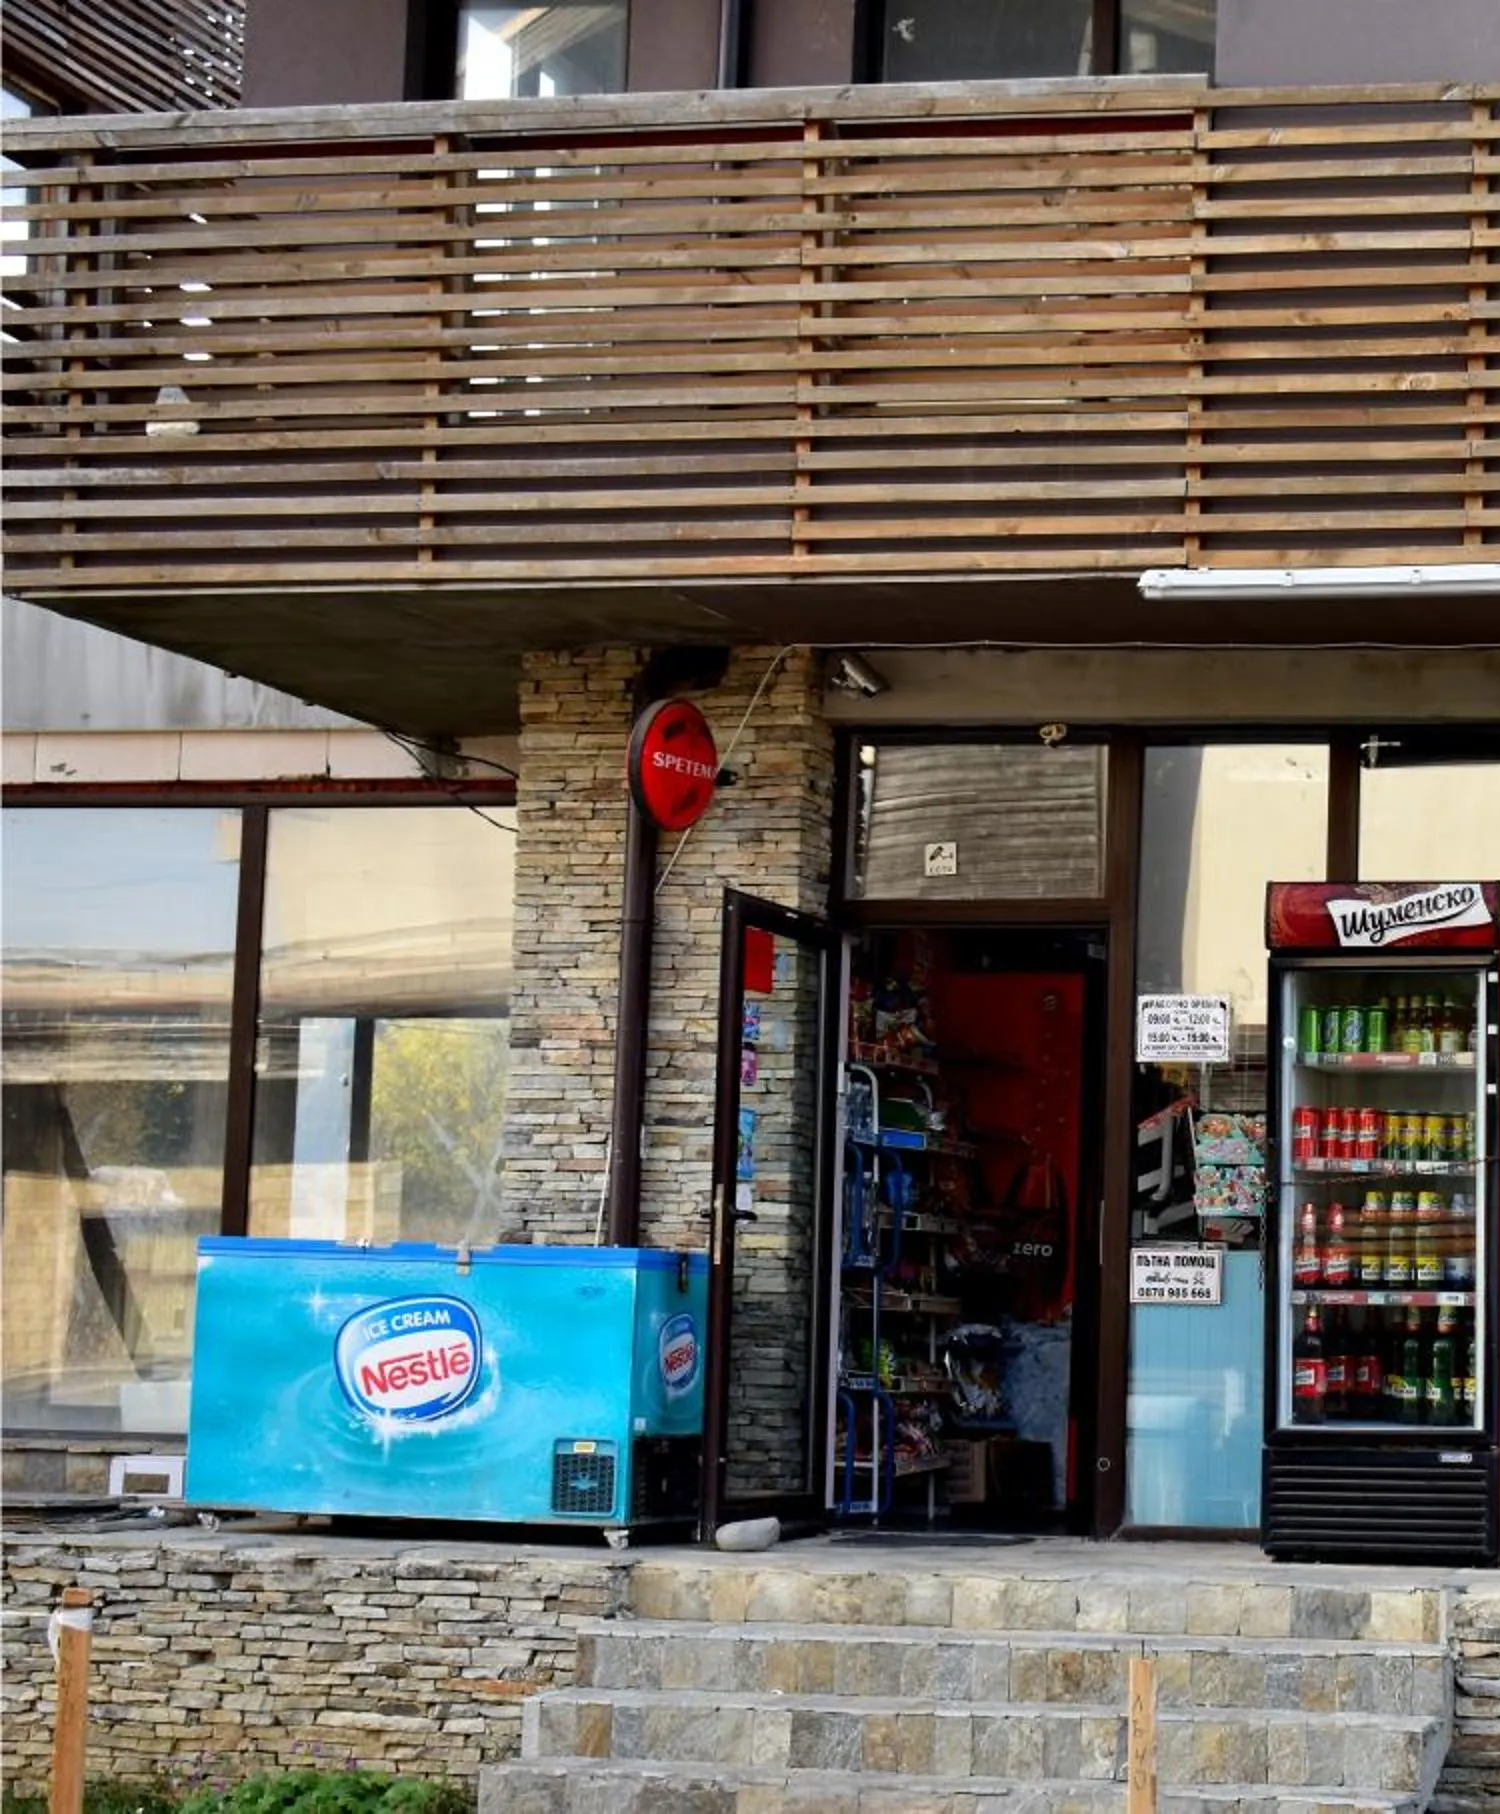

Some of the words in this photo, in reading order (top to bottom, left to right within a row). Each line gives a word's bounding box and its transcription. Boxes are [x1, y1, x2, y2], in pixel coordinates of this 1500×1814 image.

[1339, 885, 1478, 944] Шуменско
[1012, 1242, 1054, 1257] zero
[1136, 1255, 1171, 1267] ПЪТНА
[1174, 1255, 1215, 1269] ПОМОЩ
[362, 1319, 389, 1341] ICE
[391, 1309, 452, 1331] CREAM
